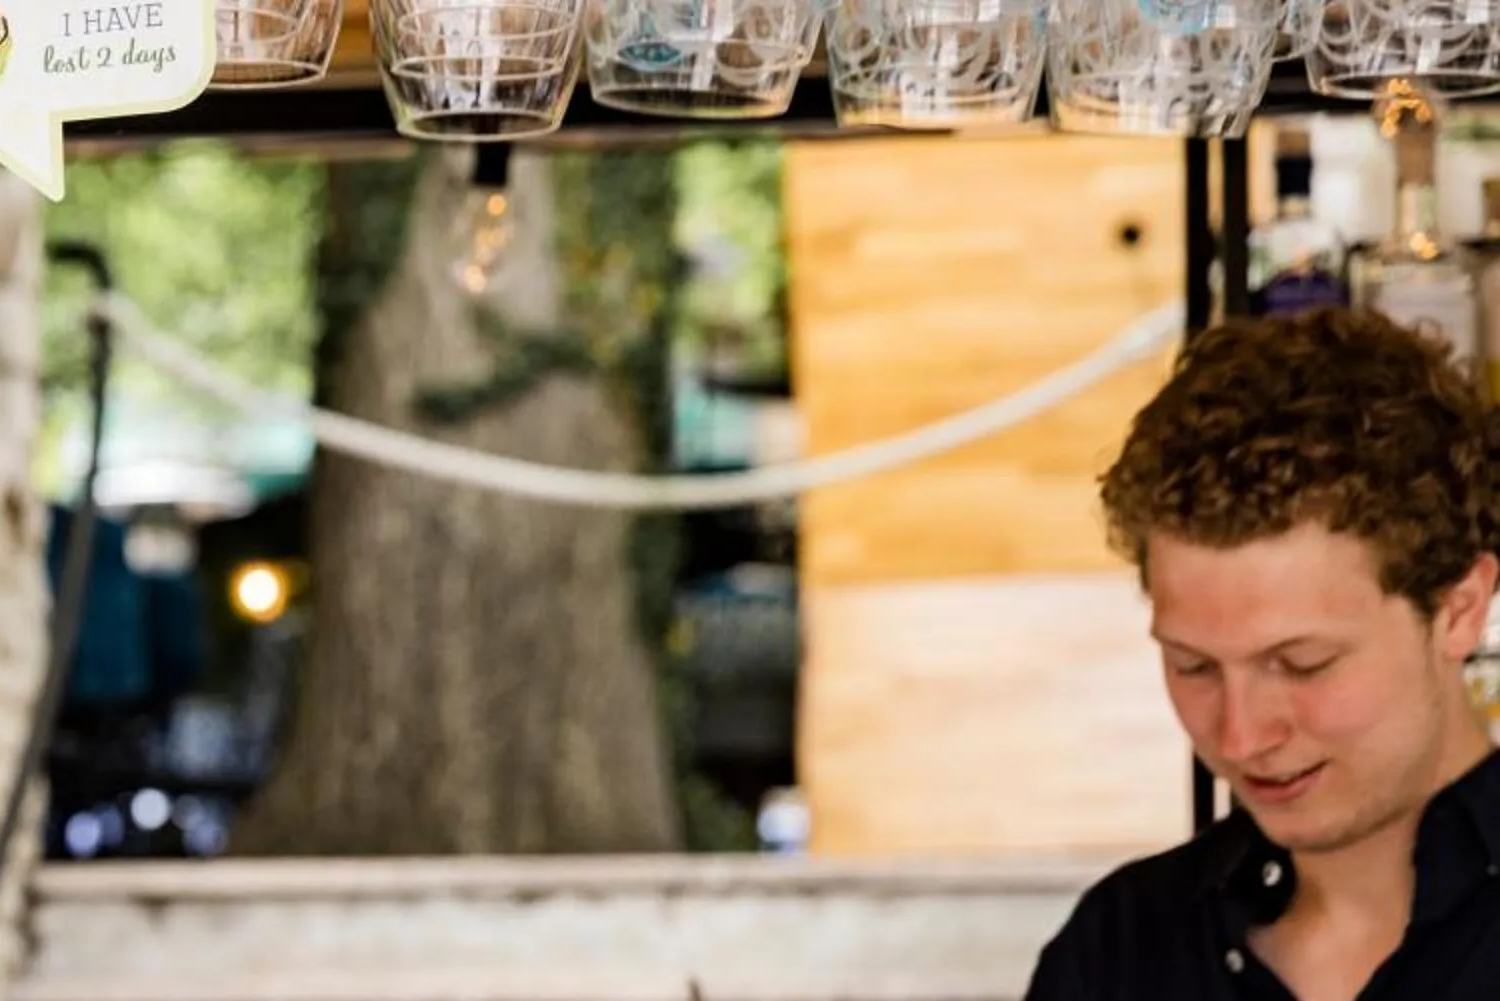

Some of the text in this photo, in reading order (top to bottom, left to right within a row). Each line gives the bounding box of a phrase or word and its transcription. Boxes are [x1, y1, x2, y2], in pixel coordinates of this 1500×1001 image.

[62, 2, 163, 37] I HAVE
[43, 37, 176, 73] lost 2 days
